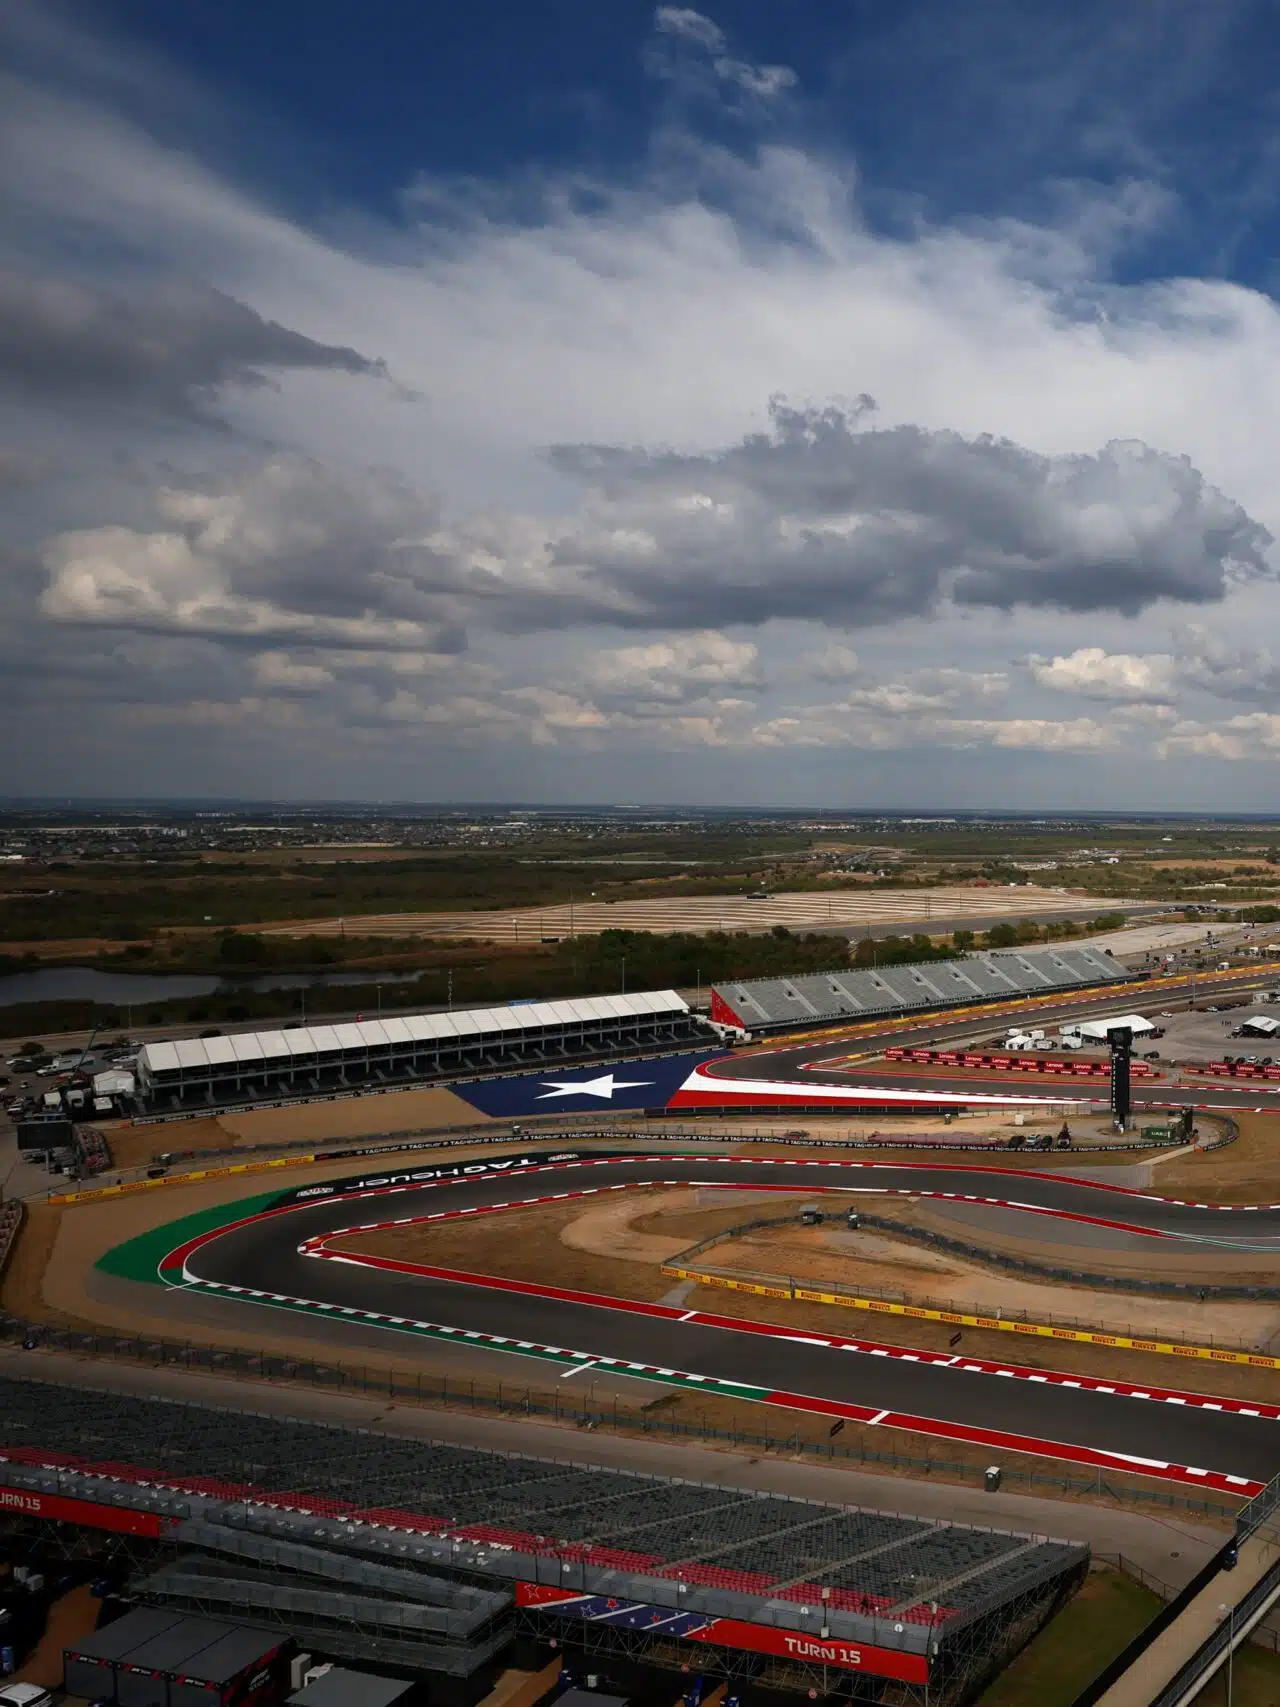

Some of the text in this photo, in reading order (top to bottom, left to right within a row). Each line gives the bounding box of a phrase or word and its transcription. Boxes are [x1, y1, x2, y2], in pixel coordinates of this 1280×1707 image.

[0, 1492, 42, 1511] URN 15
[784, 1637, 861, 1664] TURN 15
